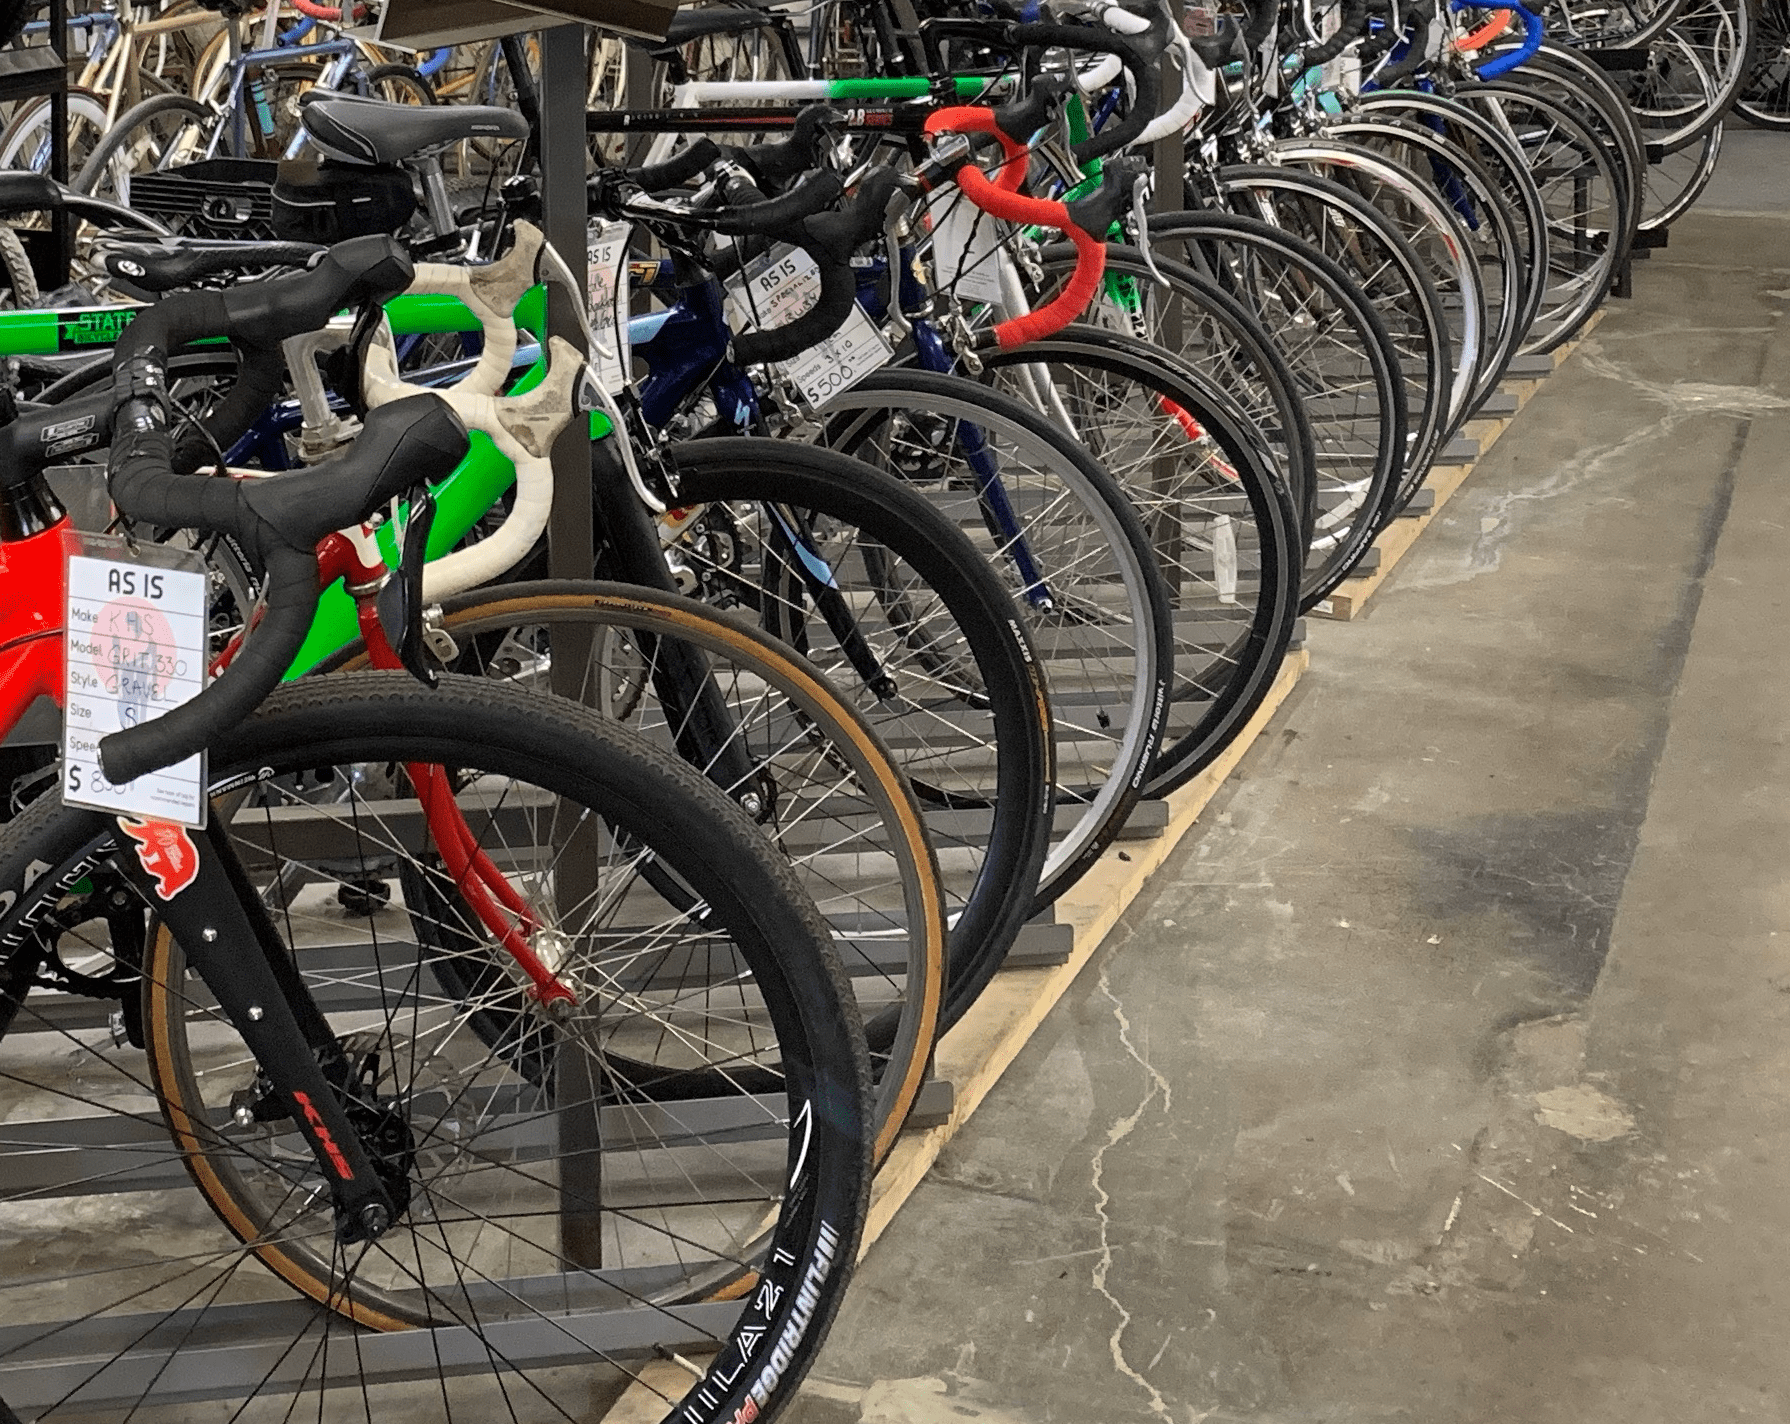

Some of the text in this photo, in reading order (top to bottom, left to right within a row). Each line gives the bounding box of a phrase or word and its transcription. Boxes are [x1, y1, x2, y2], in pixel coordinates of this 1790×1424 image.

[601, 246, 612, 263] IS
[759, 258, 797, 292] AS IS
[79, 312, 137, 331] STATE
[797, 363, 822, 384] Speeds
[824, 354, 834, 364] 3
[841, 339, 853, 352] 10
[109, 568, 165, 599] AS IS
[71, 607, 99, 624] Make
[70, 639, 103, 657] Model
[1007, 619, 1034, 663] MAXXIS
[70, 671, 179, 703] Style GRAVEL
[69, 703, 92, 719] Size
[69, 736, 101, 752] Spee
[68, 764, 82, 793] $
[292, 1089, 356, 1181] KHS
